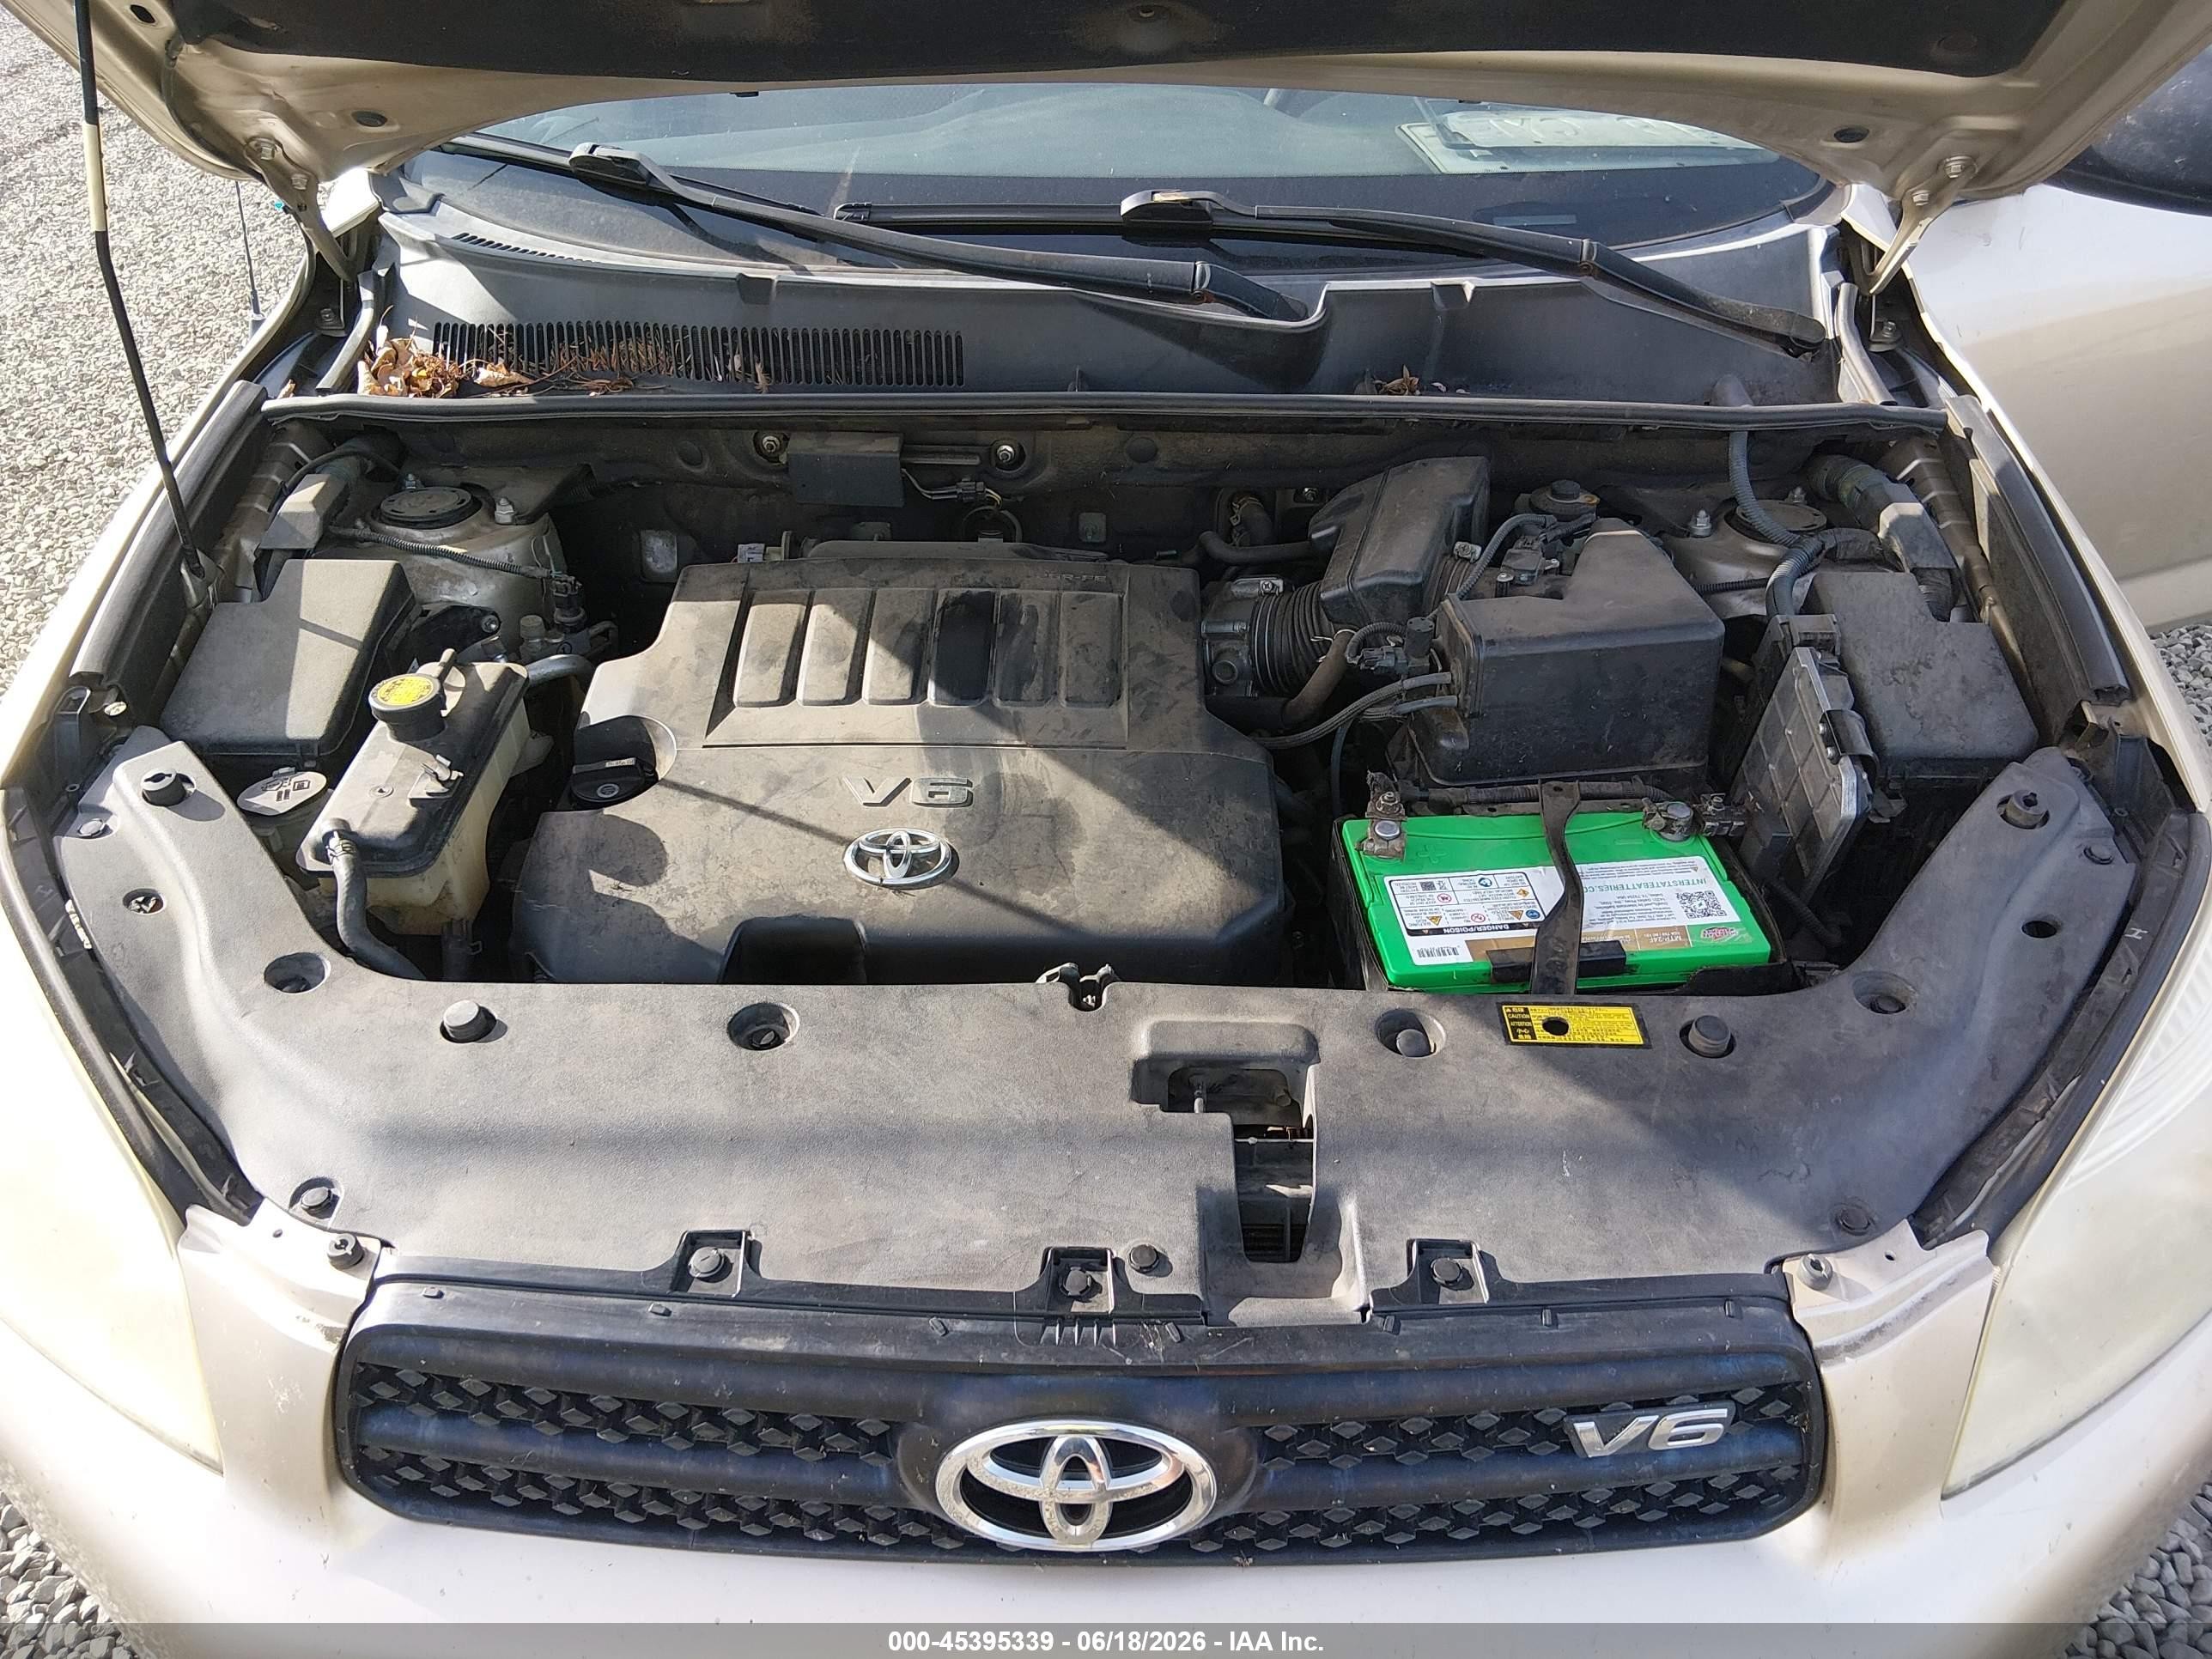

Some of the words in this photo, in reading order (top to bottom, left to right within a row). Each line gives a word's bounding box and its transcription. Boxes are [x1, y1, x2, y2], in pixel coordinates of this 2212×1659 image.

[842, 777, 974, 808] V6
[1442, 923, 1510, 933] DANGER/POISON
[1573, 1408, 1728, 1457] V6
